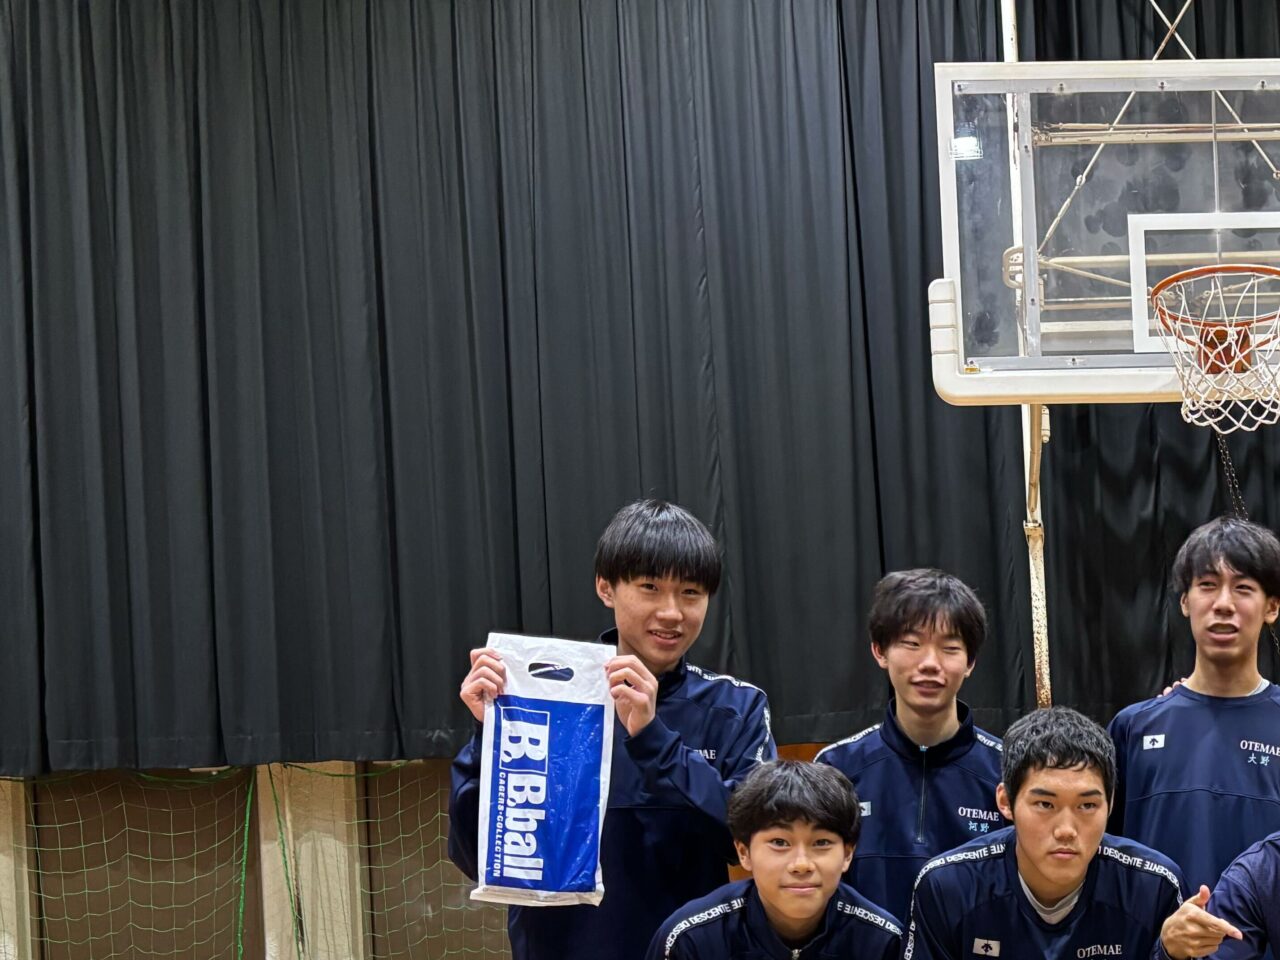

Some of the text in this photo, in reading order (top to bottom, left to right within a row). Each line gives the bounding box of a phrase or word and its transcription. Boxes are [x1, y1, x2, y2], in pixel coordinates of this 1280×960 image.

[958, 806, 999, 821] OTEMAE
[947, 847, 988, 863] DESCENTE
[1103, 846, 1143, 868] DESCENTE
[688, 903, 731, 925] DESCENTE
[1077, 944, 1122, 959] OTEMAE
